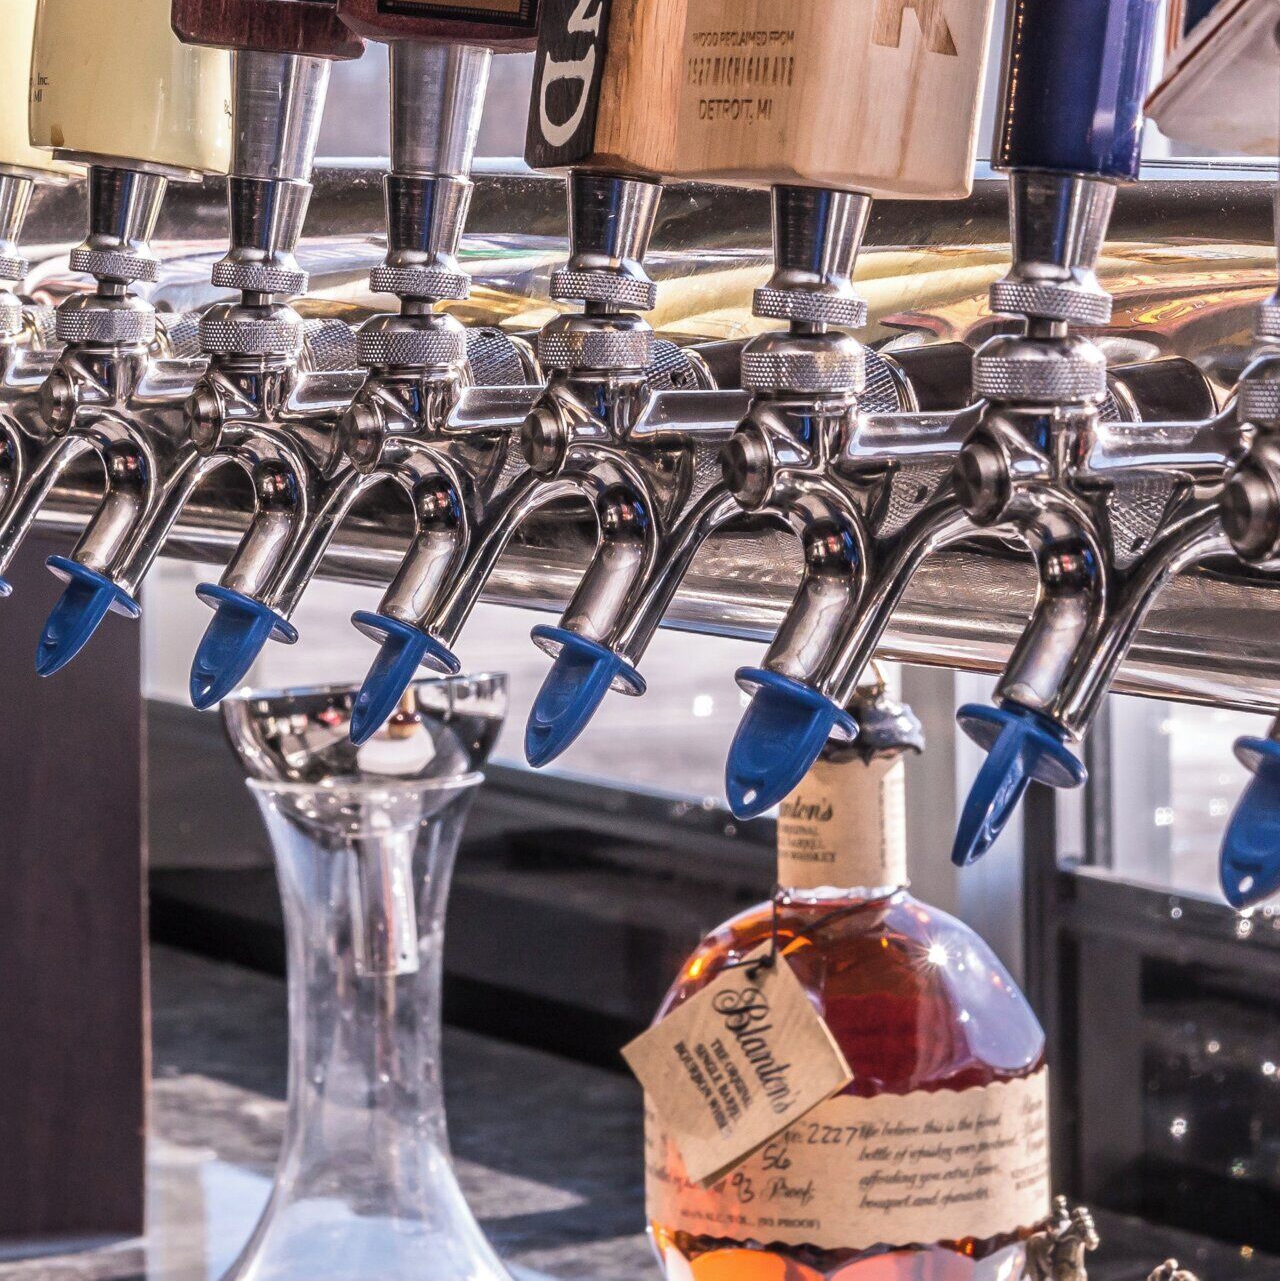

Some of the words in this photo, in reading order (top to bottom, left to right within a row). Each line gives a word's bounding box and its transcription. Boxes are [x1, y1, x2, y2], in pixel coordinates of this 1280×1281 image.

[756, 99, 773, 120] MI
[712, 987, 802, 1115] Blanton's
[808, 1123, 859, 1146] 2227
[761, 1143, 792, 1171] 56
